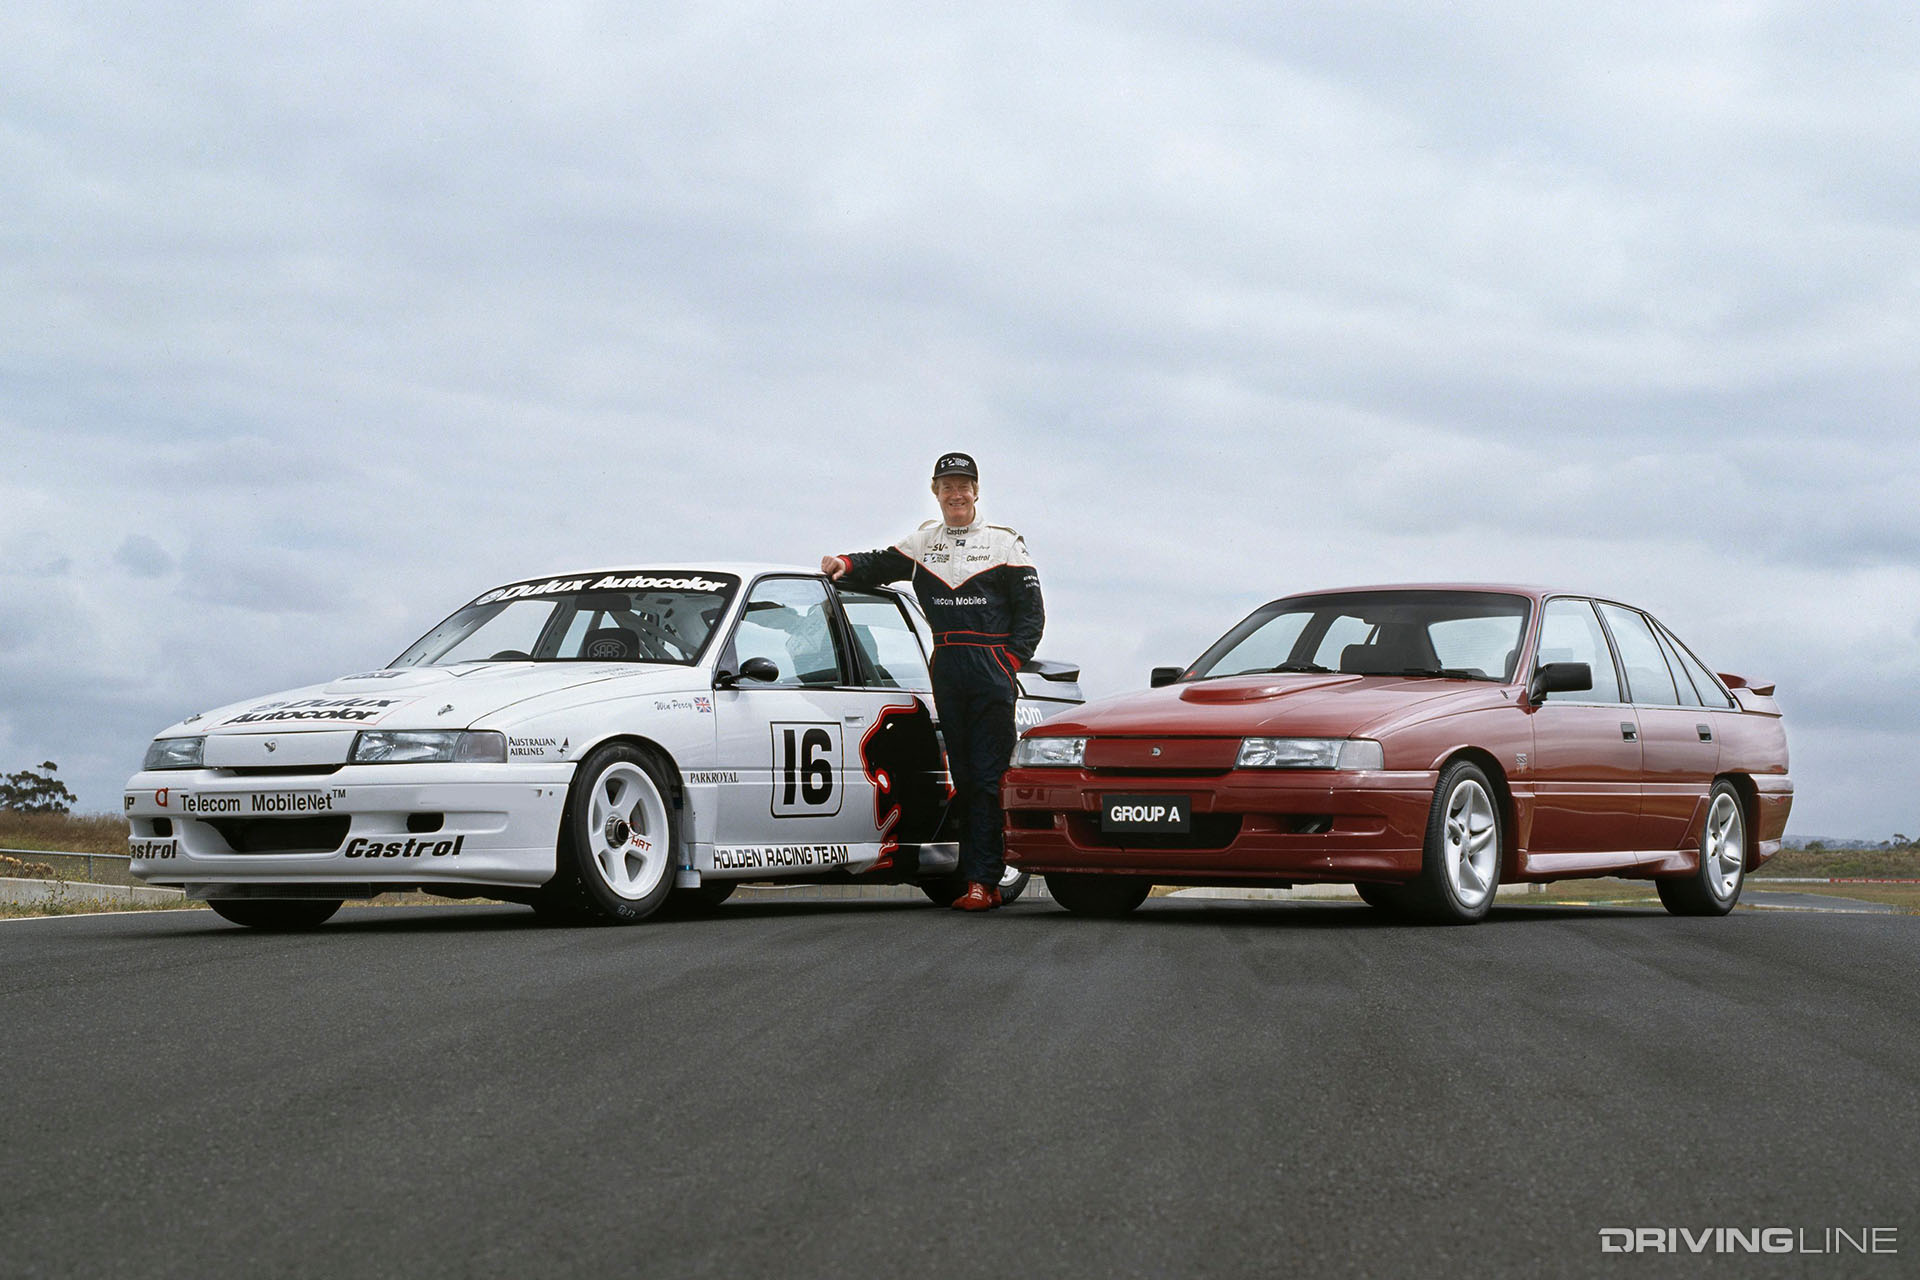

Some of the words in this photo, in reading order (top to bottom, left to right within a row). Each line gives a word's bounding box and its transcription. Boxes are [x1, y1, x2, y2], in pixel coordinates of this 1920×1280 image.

[946, 527, 969, 535] Castrol
[966, 554, 991, 562] Castrol
[495, 578, 592, 602] Dulux
[589, 575, 727, 592] Autocolor
[955, 596, 987, 606] Mobiles
[280, 698, 401, 710] Dulux
[220, 708, 379, 725] Autocolor
[508, 736, 557, 747] AUSTRALIAN
[510, 747, 545, 756] AIRLINES
[782, 728, 833, 806] 16
[689, 771, 740, 784] PARKROYAL
[180, 794, 241, 812] Telecom
[1110, 805, 1166, 823] GROUP
[1167, 806, 1181, 823] A
[130, 839, 178, 860] astrol
[344, 835, 465, 859] Castrol
[713, 848, 764, 870] HOLDEN
[766, 846, 814, 867] RACING
[815, 844, 850, 864] TEAM
